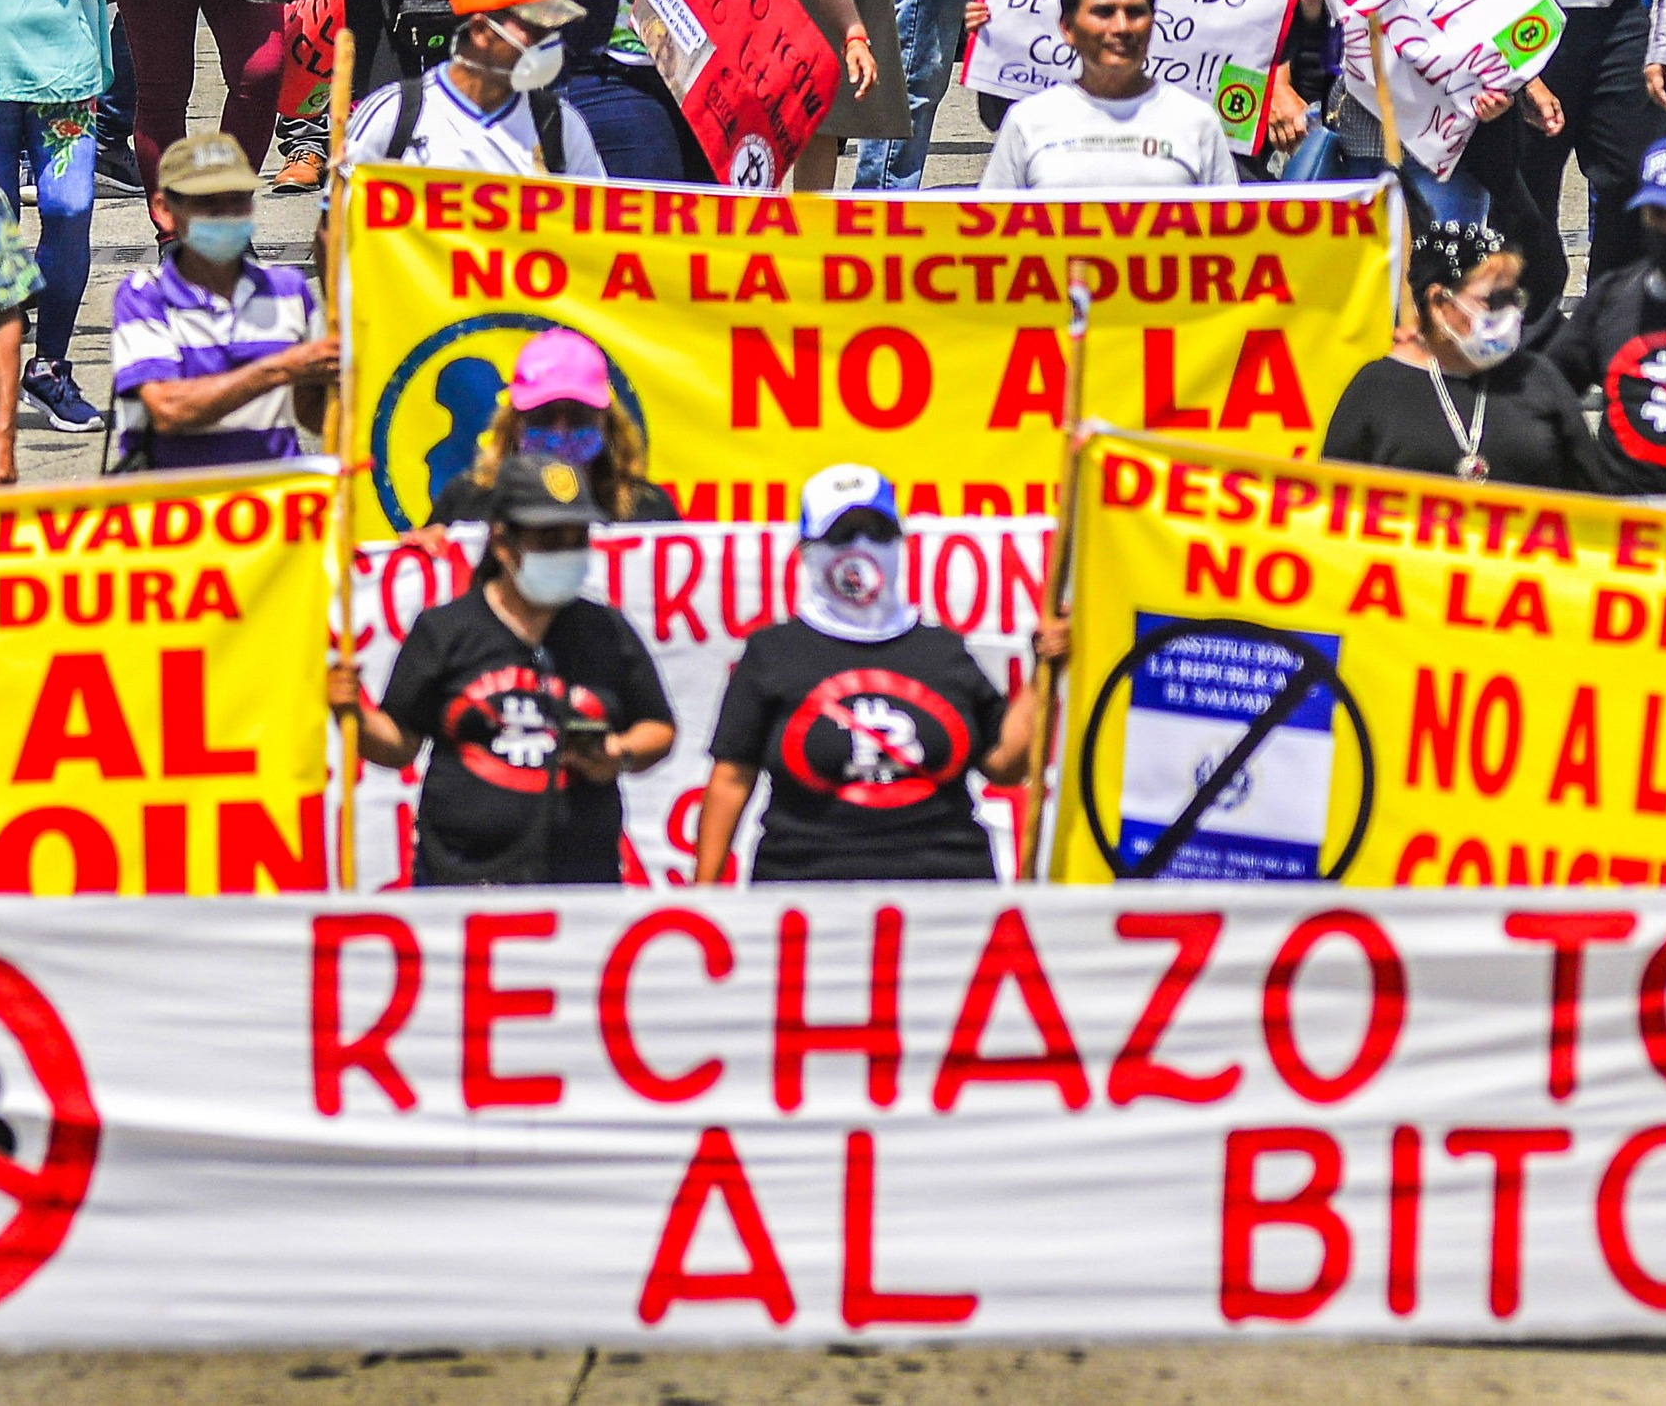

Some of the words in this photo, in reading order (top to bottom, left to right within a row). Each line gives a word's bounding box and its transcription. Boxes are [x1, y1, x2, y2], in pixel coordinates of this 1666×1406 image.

[366, 180, 799, 236] DESPIERTA
[835, 199, 923, 236] EL
[957, 197, 1375, 237] SALVADOR
[452, 250, 568, 299] NO
[602, 253, 654, 299] A
[690, 254, 787, 301] LA
[824, 255, 1292, 303] DICTADURA
[731, 326, 932, 430] NO
[988, 327, 1069, 429] A
[1144, 328, 1312, 431] LA
[1101, 452, 1571, 563] DESPIERTA
[1186, 542, 1311, 606] NO
[1349, 563, 1402, 618] A
[1446, 573, 1549, 635] LA
[12, 649, 256, 782] AL
[1148, 654, 1175, 677] LA
[1164, 682, 1185, 700] EL
[1194, 685, 1272, 715] SALVAD
[1406, 667, 1521, 797] NO
[1549, 686, 1598, 806] A
[310, 904, 1408, 1119] RECHAZO
[637, 1124, 979, 1332] AL
